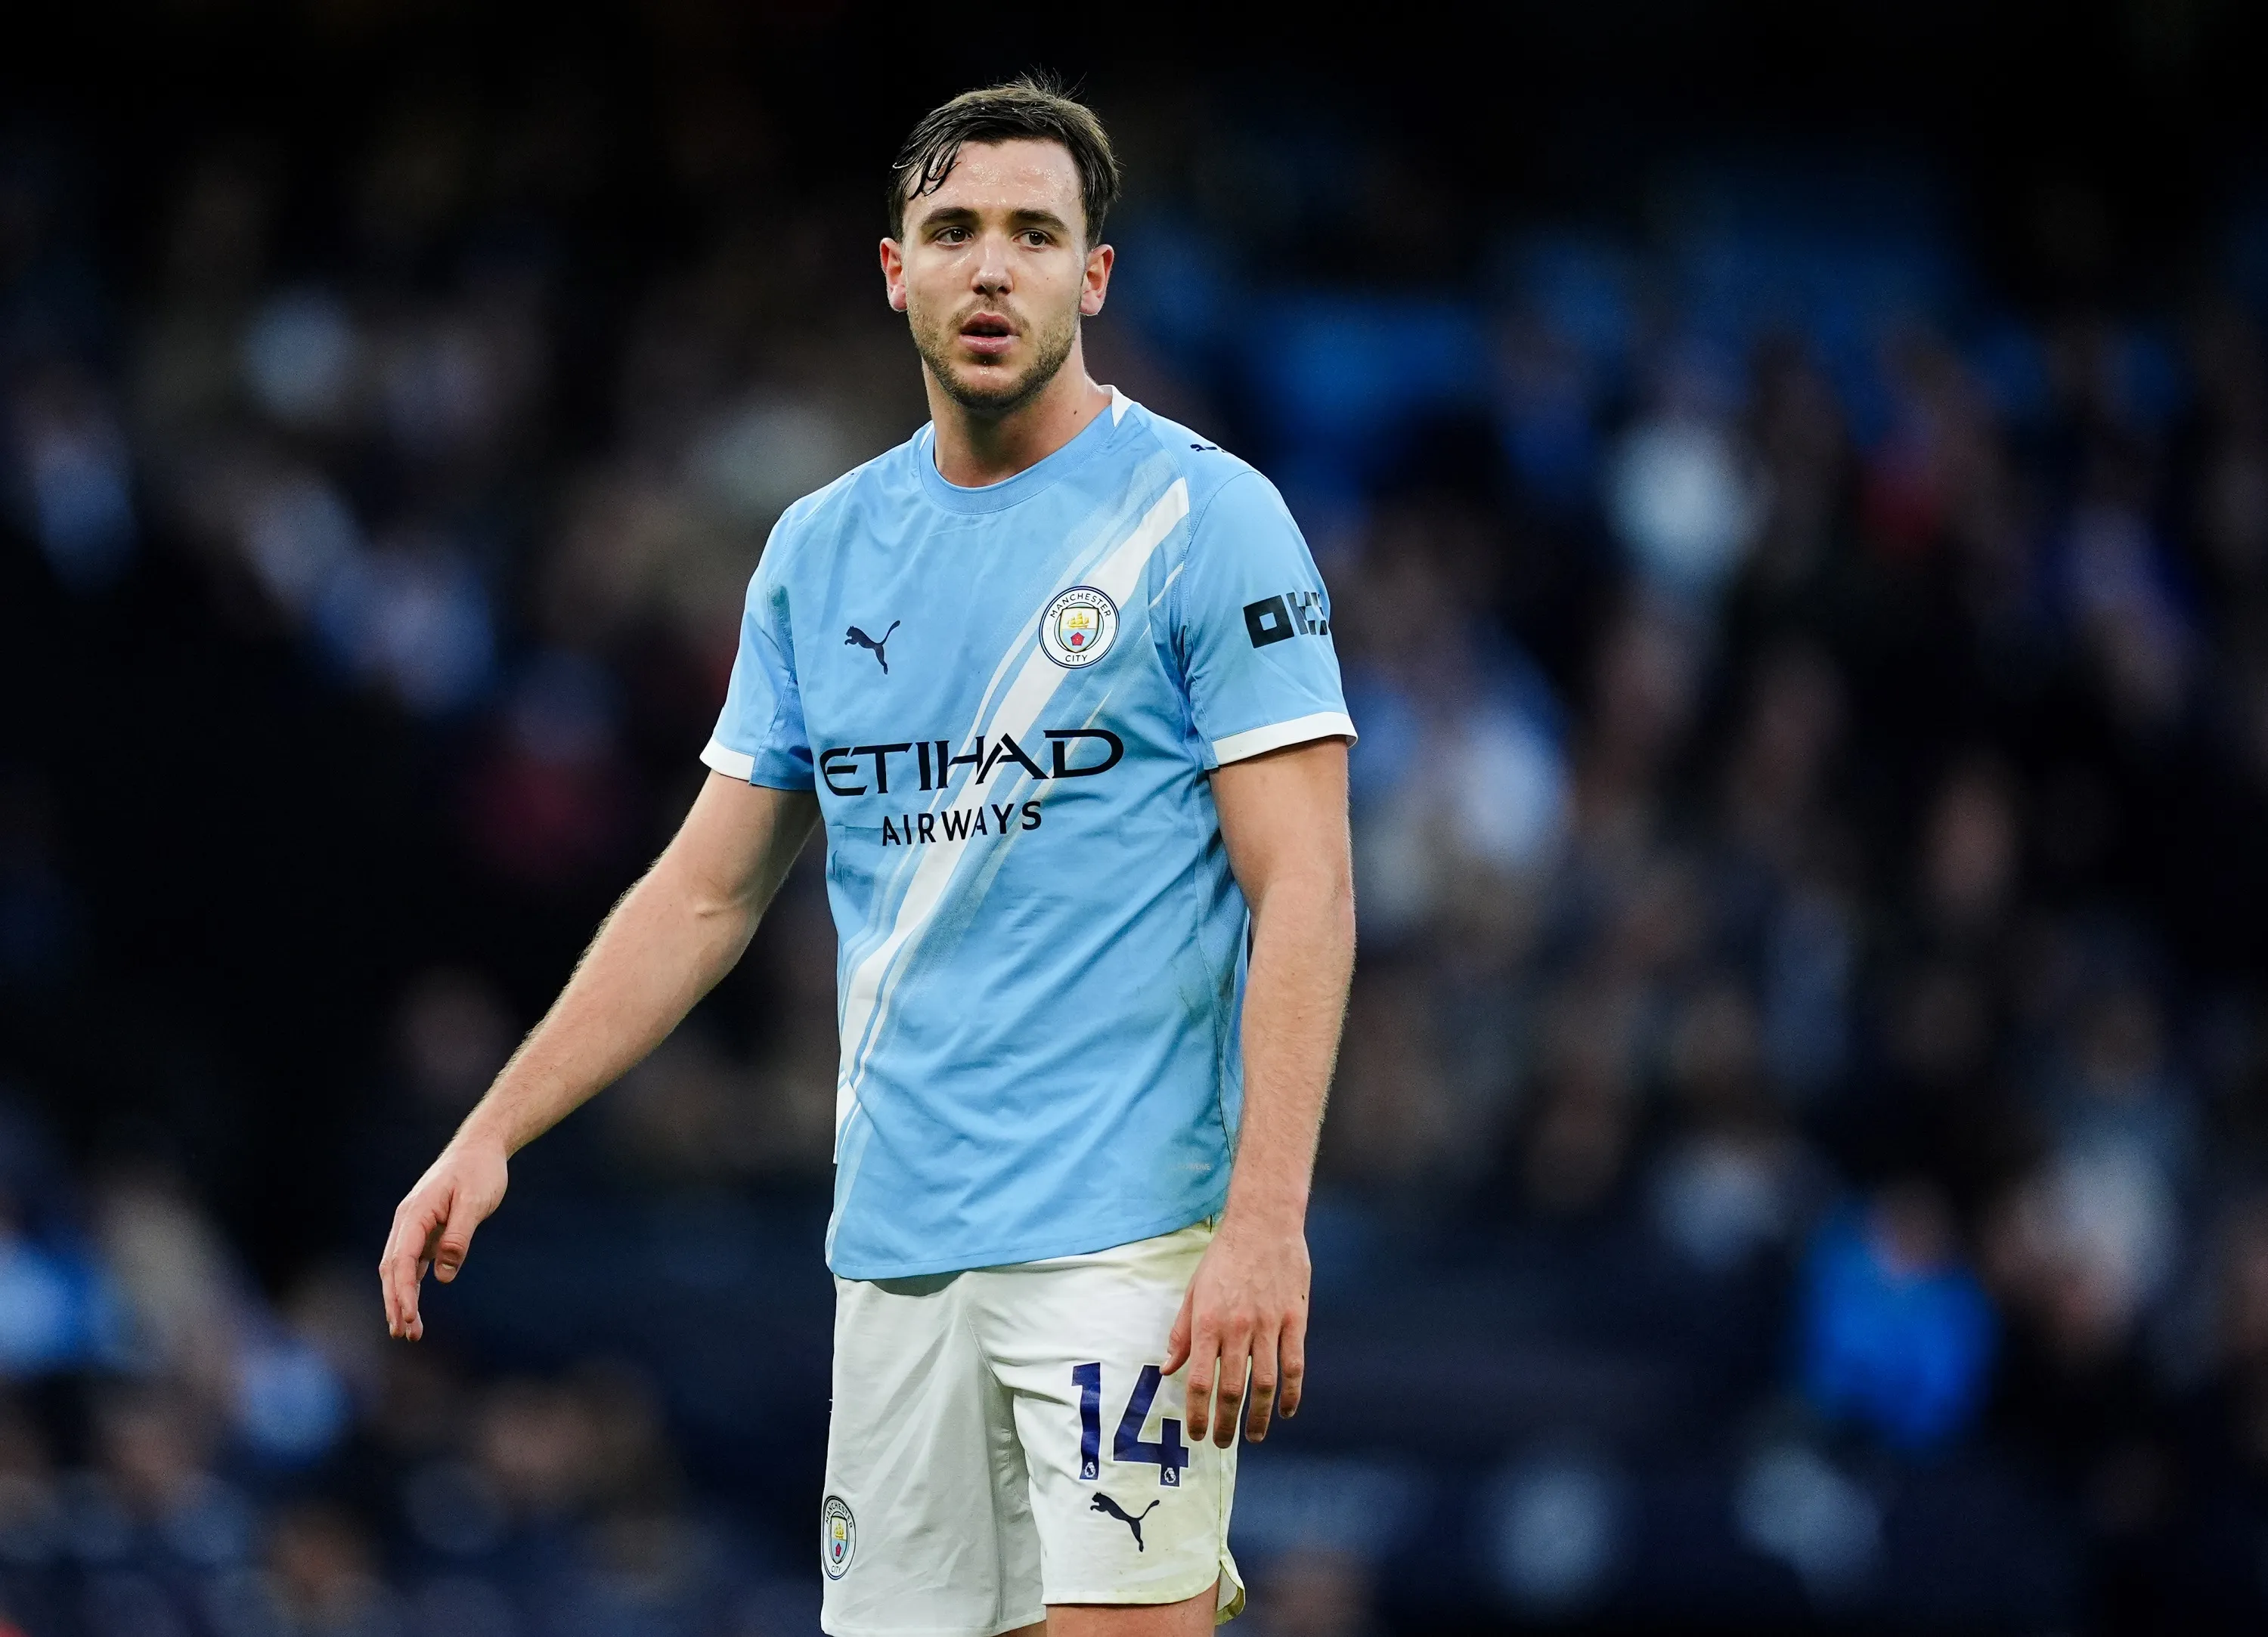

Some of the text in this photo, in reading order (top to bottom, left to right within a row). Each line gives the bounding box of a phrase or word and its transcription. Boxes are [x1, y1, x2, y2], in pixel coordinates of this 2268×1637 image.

[1050, 593, 1111, 618] MANCHESTER
[820, 729, 1124, 797] ETIHAD
[882, 801, 1042, 846] AIRWAYS
[1071, 1362, 1190, 1488] 14
[826, 1502, 853, 1528] MANCHESTER
